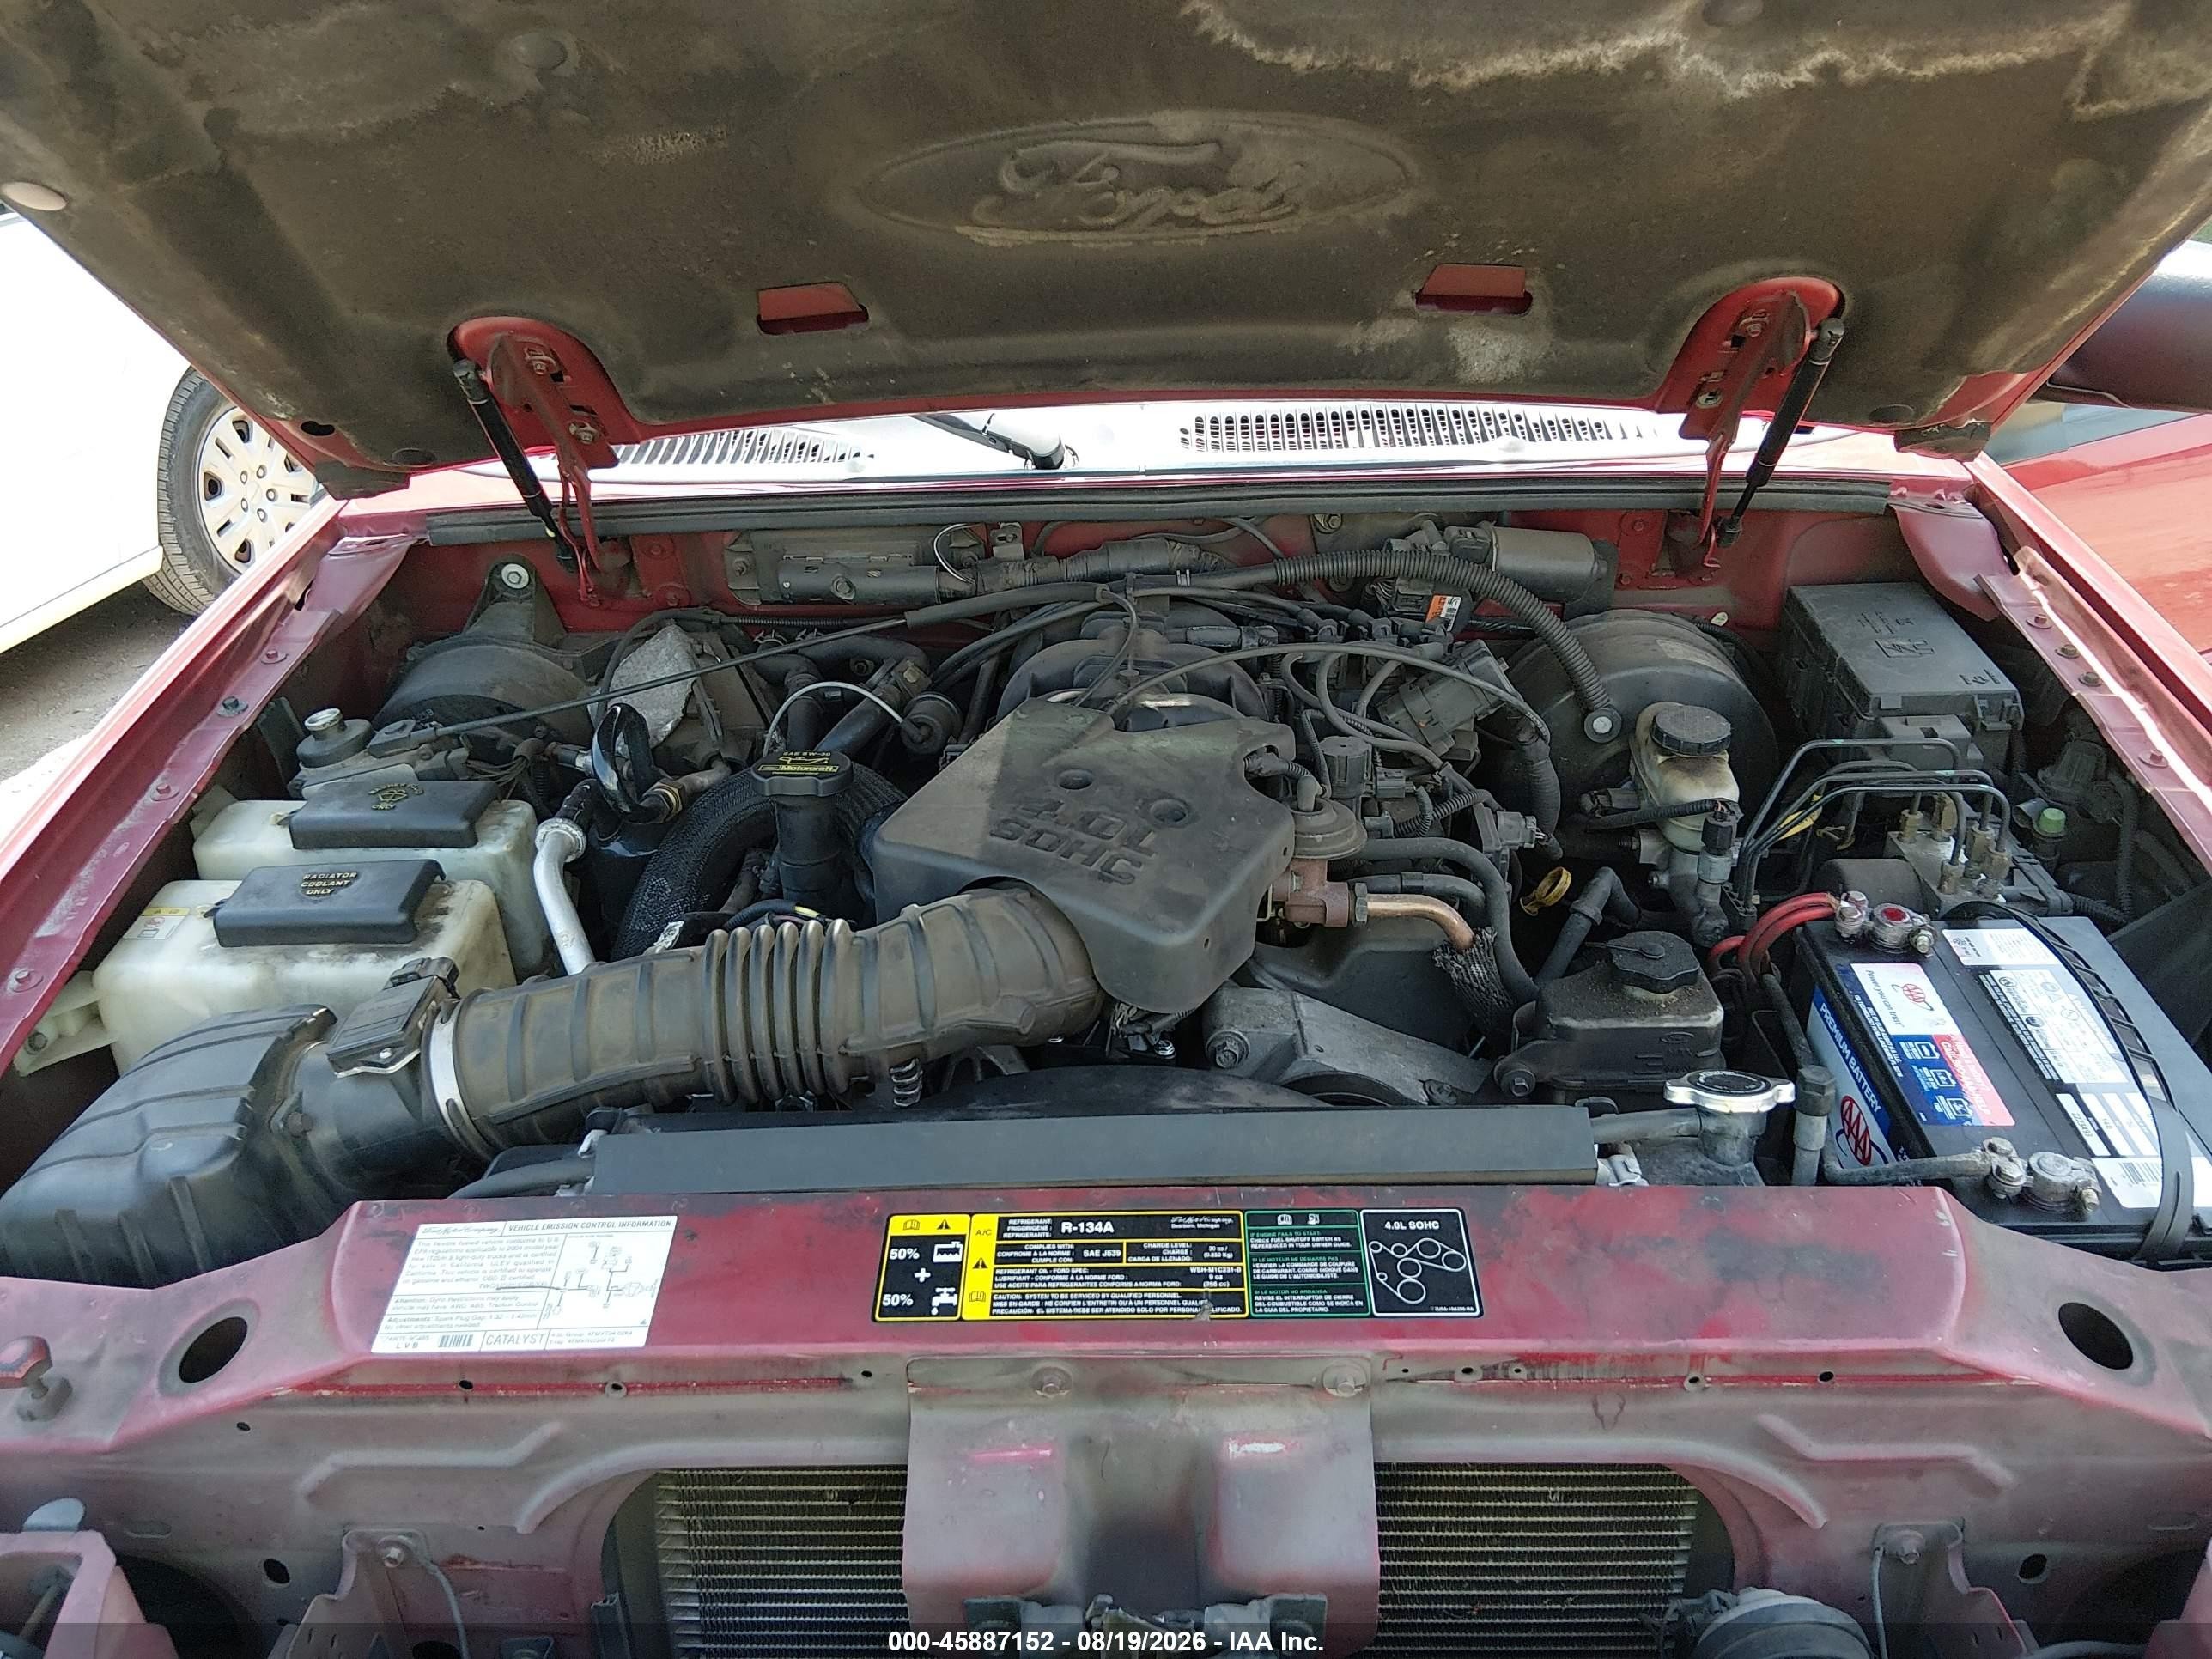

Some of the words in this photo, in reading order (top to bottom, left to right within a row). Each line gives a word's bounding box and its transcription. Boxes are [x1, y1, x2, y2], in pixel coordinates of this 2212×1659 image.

[989, 817, 1144, 885] SOHC
[1820, 1003, 1850, 1060] PREMIUM
[1848, 1058, 1882, 1113] BATTERY
[1060, 1221, 1115, 1233] R-134A
[1384, 1221, 1407, 1230] 4.0L
[1408, 1220, 1440, 1230] SOHC
[889, 1248, 920, 1260] 50%
[882, 1294, 914, 1306] 50%
[485, 1334, 545, 1346] CATALYST
